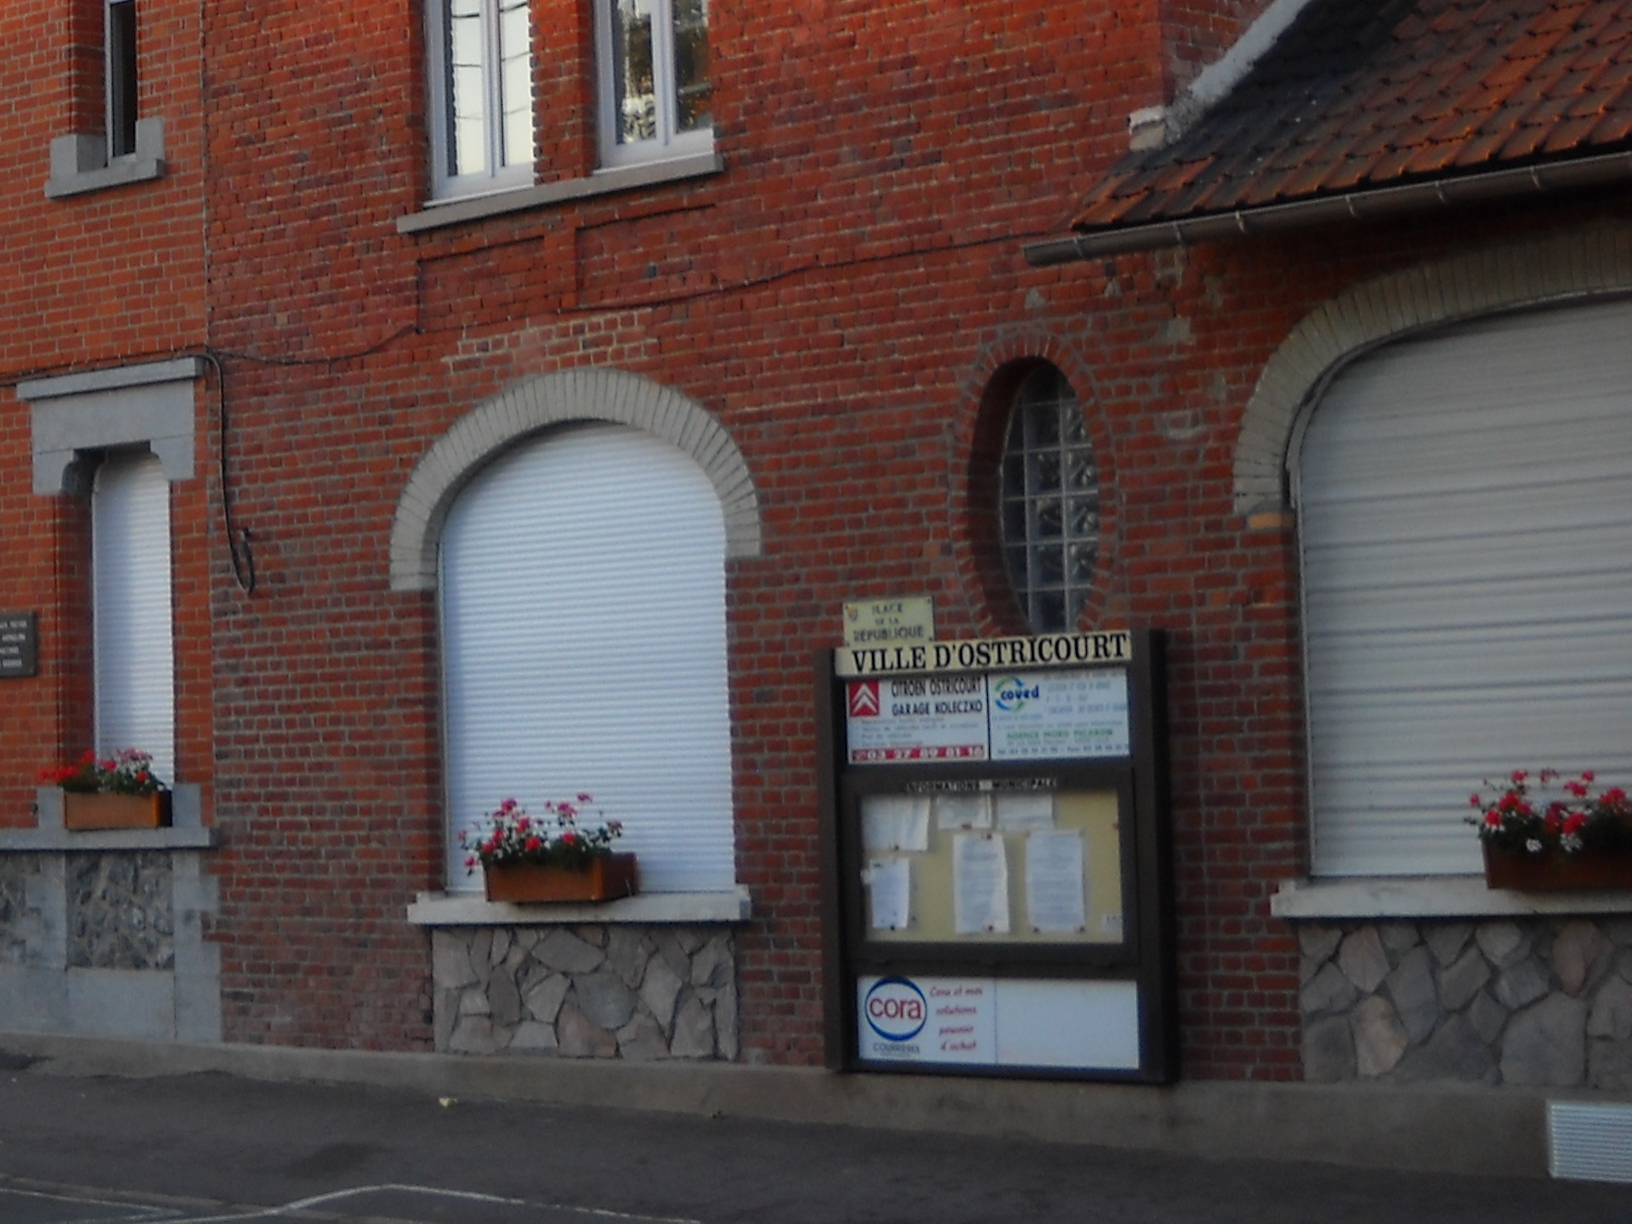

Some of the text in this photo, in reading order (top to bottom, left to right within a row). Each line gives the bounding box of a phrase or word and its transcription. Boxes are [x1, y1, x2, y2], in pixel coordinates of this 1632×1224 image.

[852, 633, 1127, 673] VILLE D'OSTRICOURT
[930, 676, 982, 695] OSTRICOURT
[1000, 684, 1039, 700] coved
[892, 699, 983, 716] GARAGE KOLECZKO
[870, 997, 922, 1019] cora
